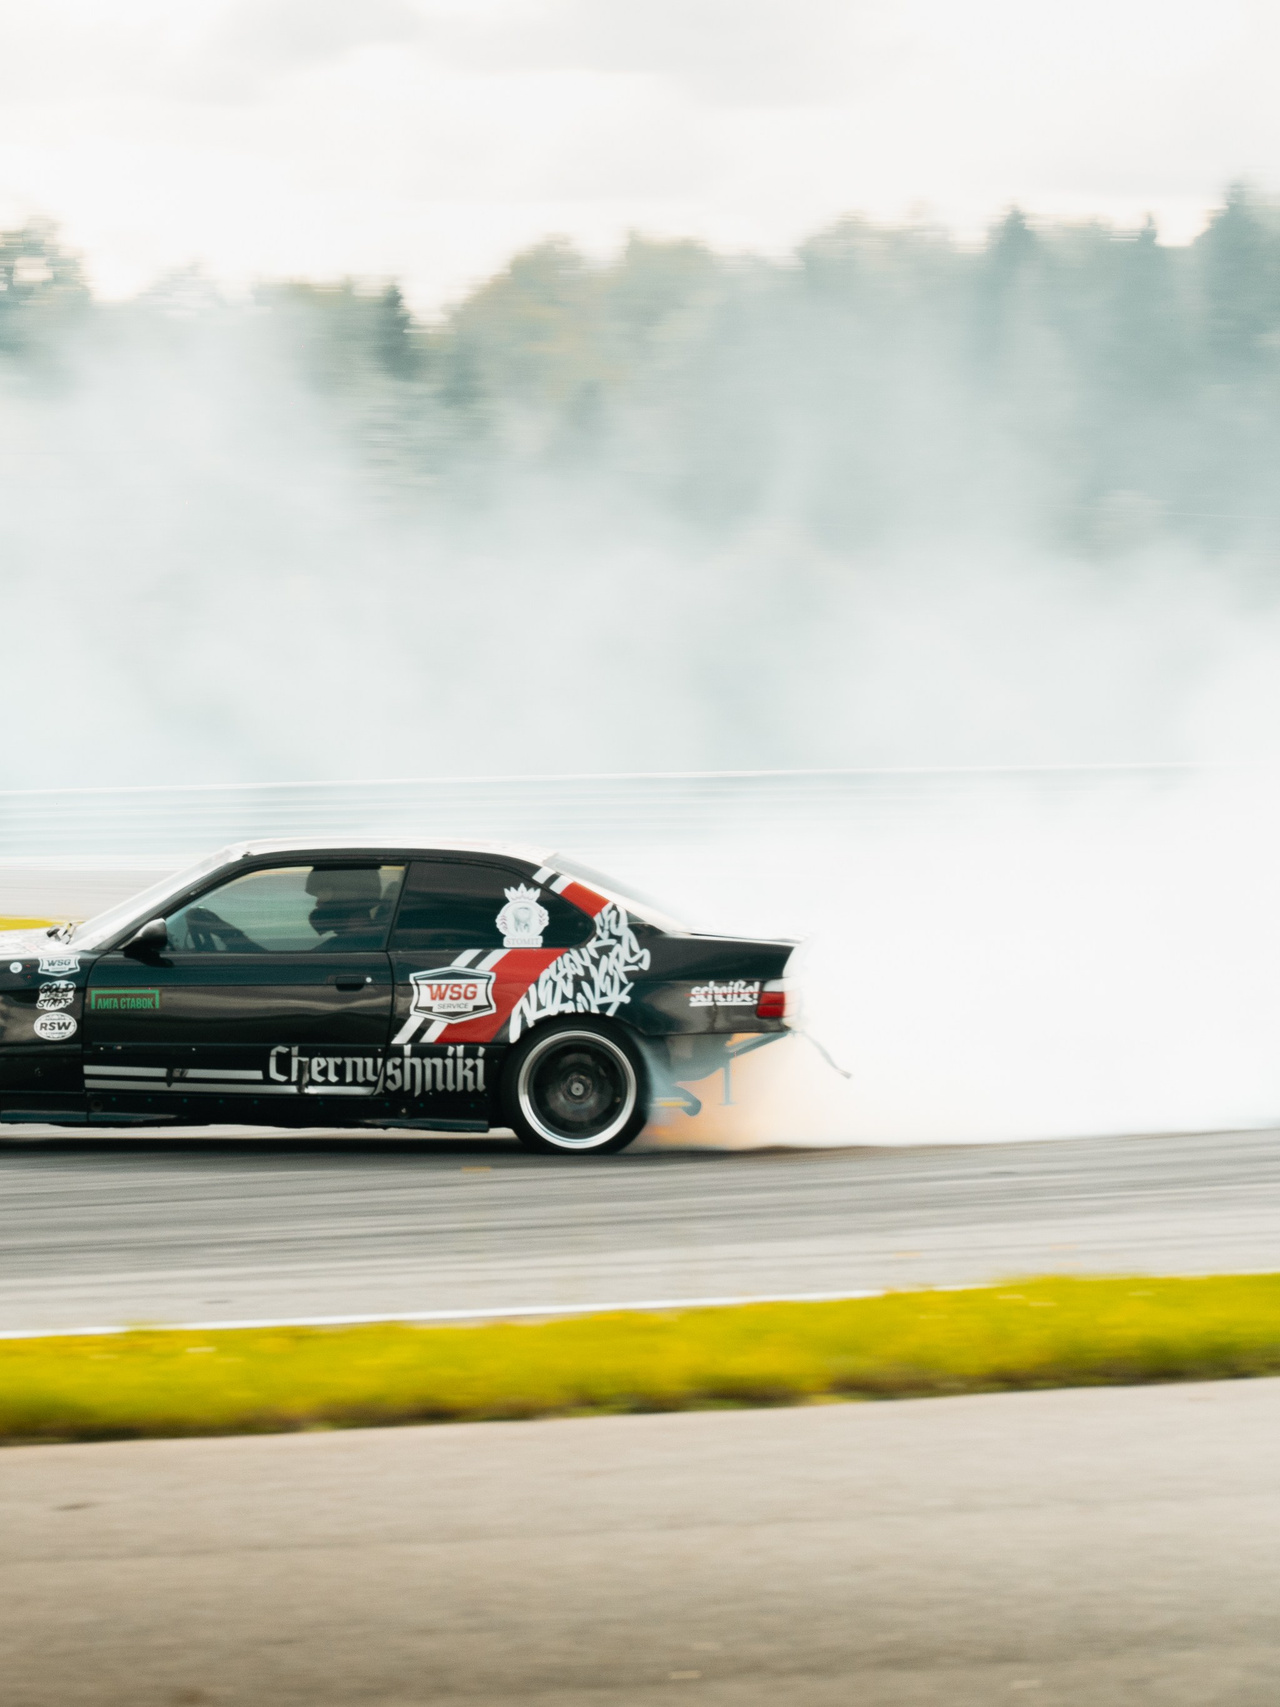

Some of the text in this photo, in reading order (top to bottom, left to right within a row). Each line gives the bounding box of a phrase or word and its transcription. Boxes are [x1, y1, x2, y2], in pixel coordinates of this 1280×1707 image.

[47, 959, 71, 967] WSG
[40, 983, 75, 993] GOLD
[426, 983, 478, 1001] WSG
[37, 997, 73, 1008] STAFF
[97, 998, 154, 1009] ЛИГА СТАВОК
[39, 1022, 72, 1031] RSW
[269, 1043, 486, 1098] Chernyshniki
